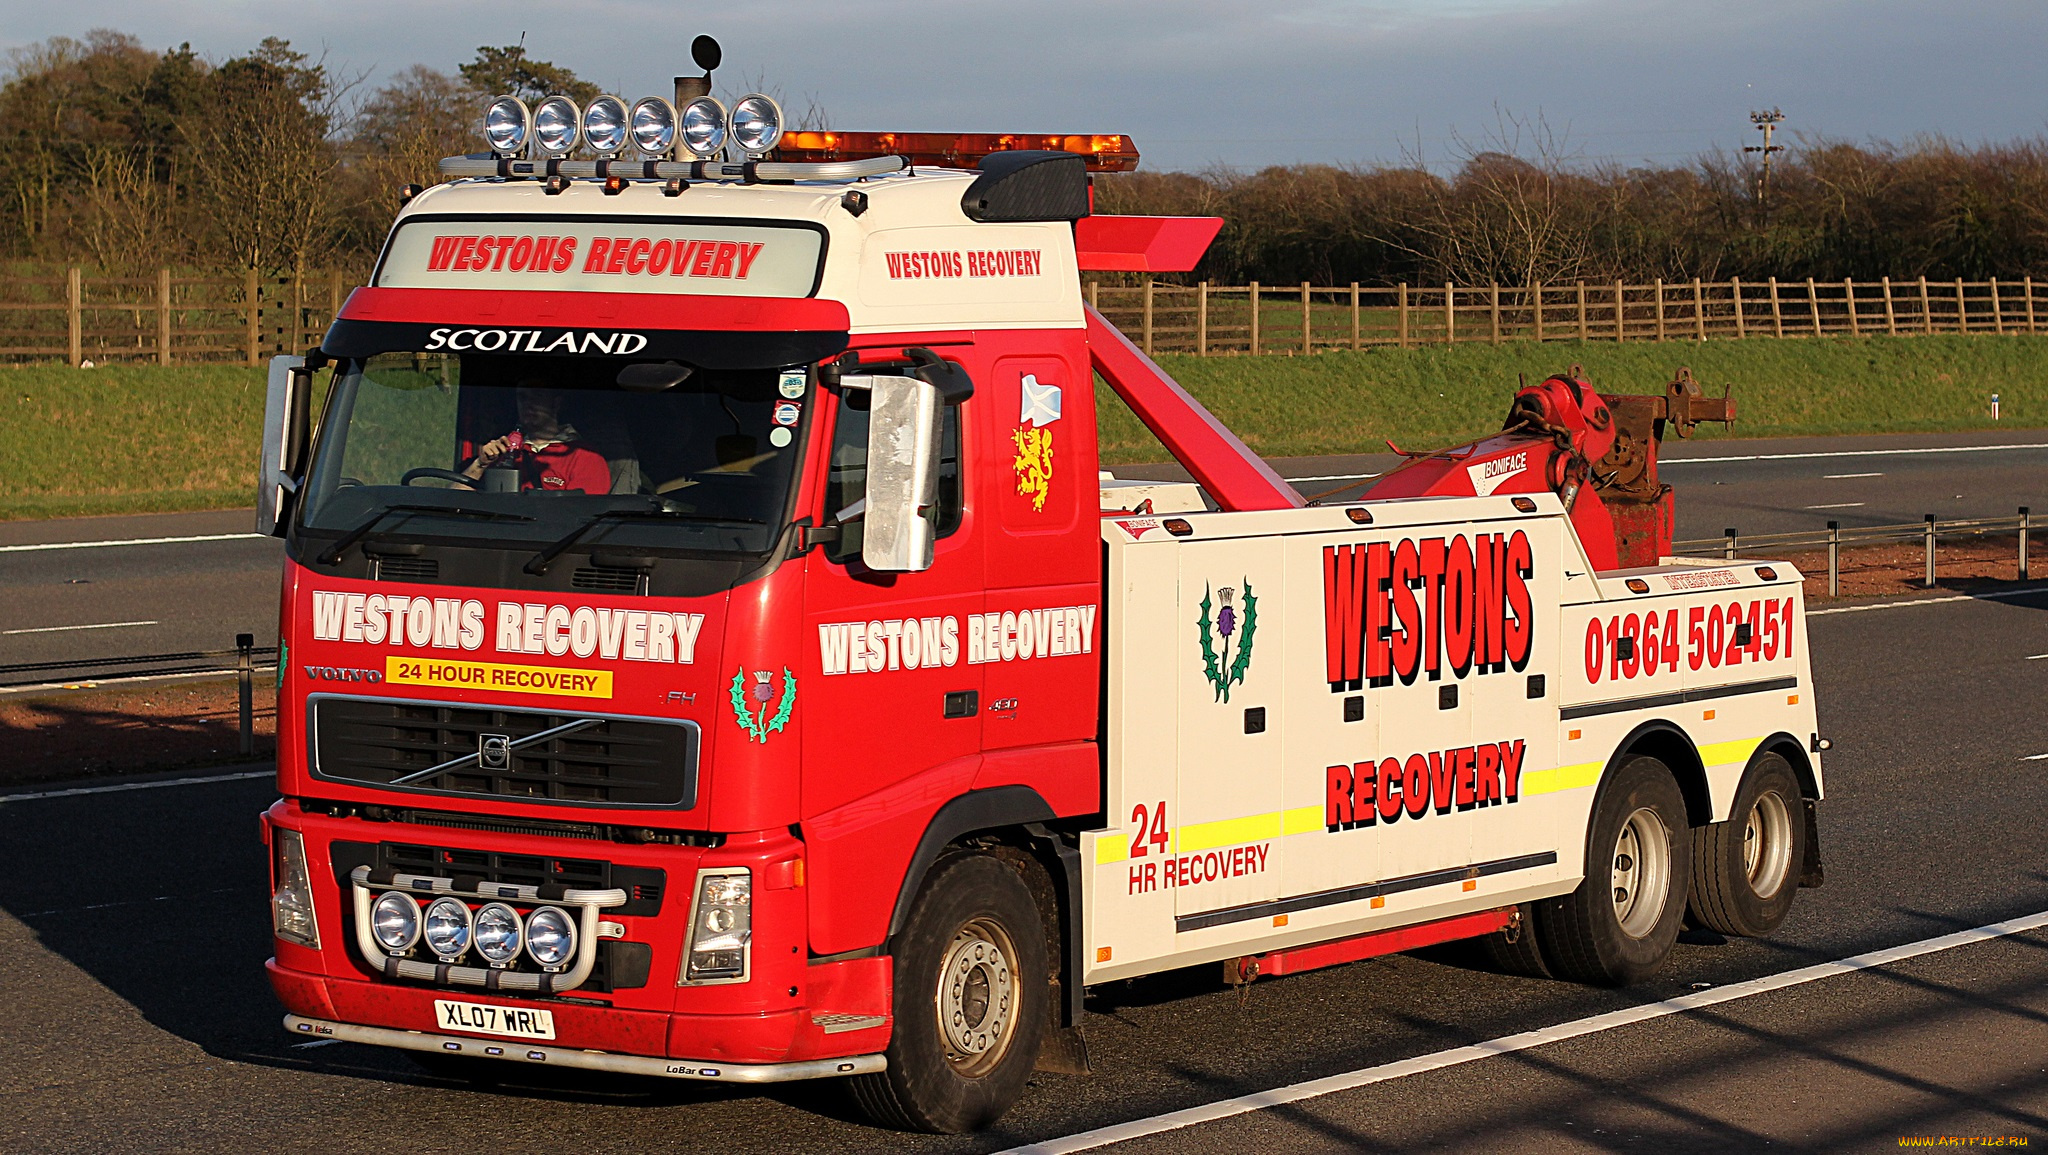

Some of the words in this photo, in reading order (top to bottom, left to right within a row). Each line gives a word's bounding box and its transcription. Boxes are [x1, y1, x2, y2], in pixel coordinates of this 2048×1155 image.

[426, 234, 577, 274] WESTONS
[583, 236, 765, 280] RECOVERY
[885, 250, 963, 280] WESTONS
[968, 248, 1042, 278] RECOVERY
[425, 328, 648, 355] SCOTLAND
[1485, 452, 1526, 478] BONIFACE
[312, 590, 485, 652] WESTONS
[495, 601, 705, 665] RECOVERY
[1323, 529, 1533, 693] WESTONS
[818, 615, 960, 676] WESTONS
[968, 604, 1097, 665] RECOVERY
[1584, 608, 1680, 684] 01364
[1688, 597, 1794, 672] 502451
[303, 665, 383, 684] VOLVO
[398, 663, 422, 679] 24
[430, 665, 485, 684] HOUR
[491, 669, 598, 692] RECOVERY
[666, 691, 697, 706] FH
[1326, 739, 1527, 832] RECOVERY
[1130, 801, 1169, 858] 24
[1128, 865, 1157, 895] HR
[1163, 843, 1270, 890] RECOVERY
[443, 1003, 496, 1030] XL07
[502, 1010, 546, 1034] WRL
[666, 1065, 697, 1075] LoBar
